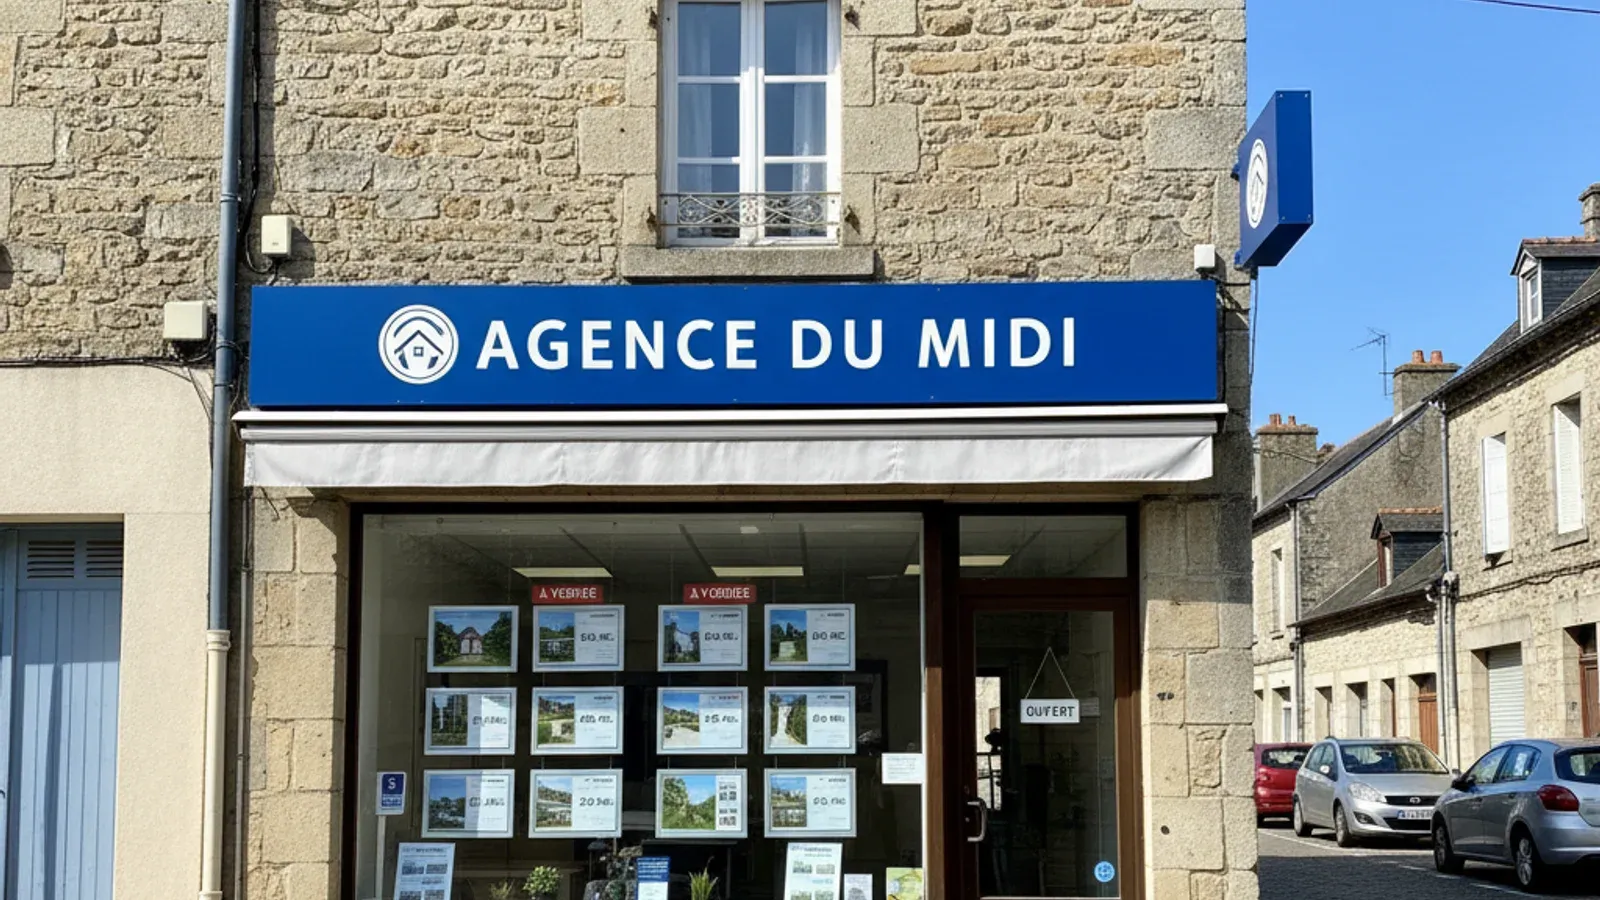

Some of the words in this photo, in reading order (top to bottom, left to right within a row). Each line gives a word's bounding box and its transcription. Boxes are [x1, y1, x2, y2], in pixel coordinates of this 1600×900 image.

[476, 319, 757, 370] AGENCE
[792, 319, 883, 370] DU
[918, 317, 1075, 368] MIDI
